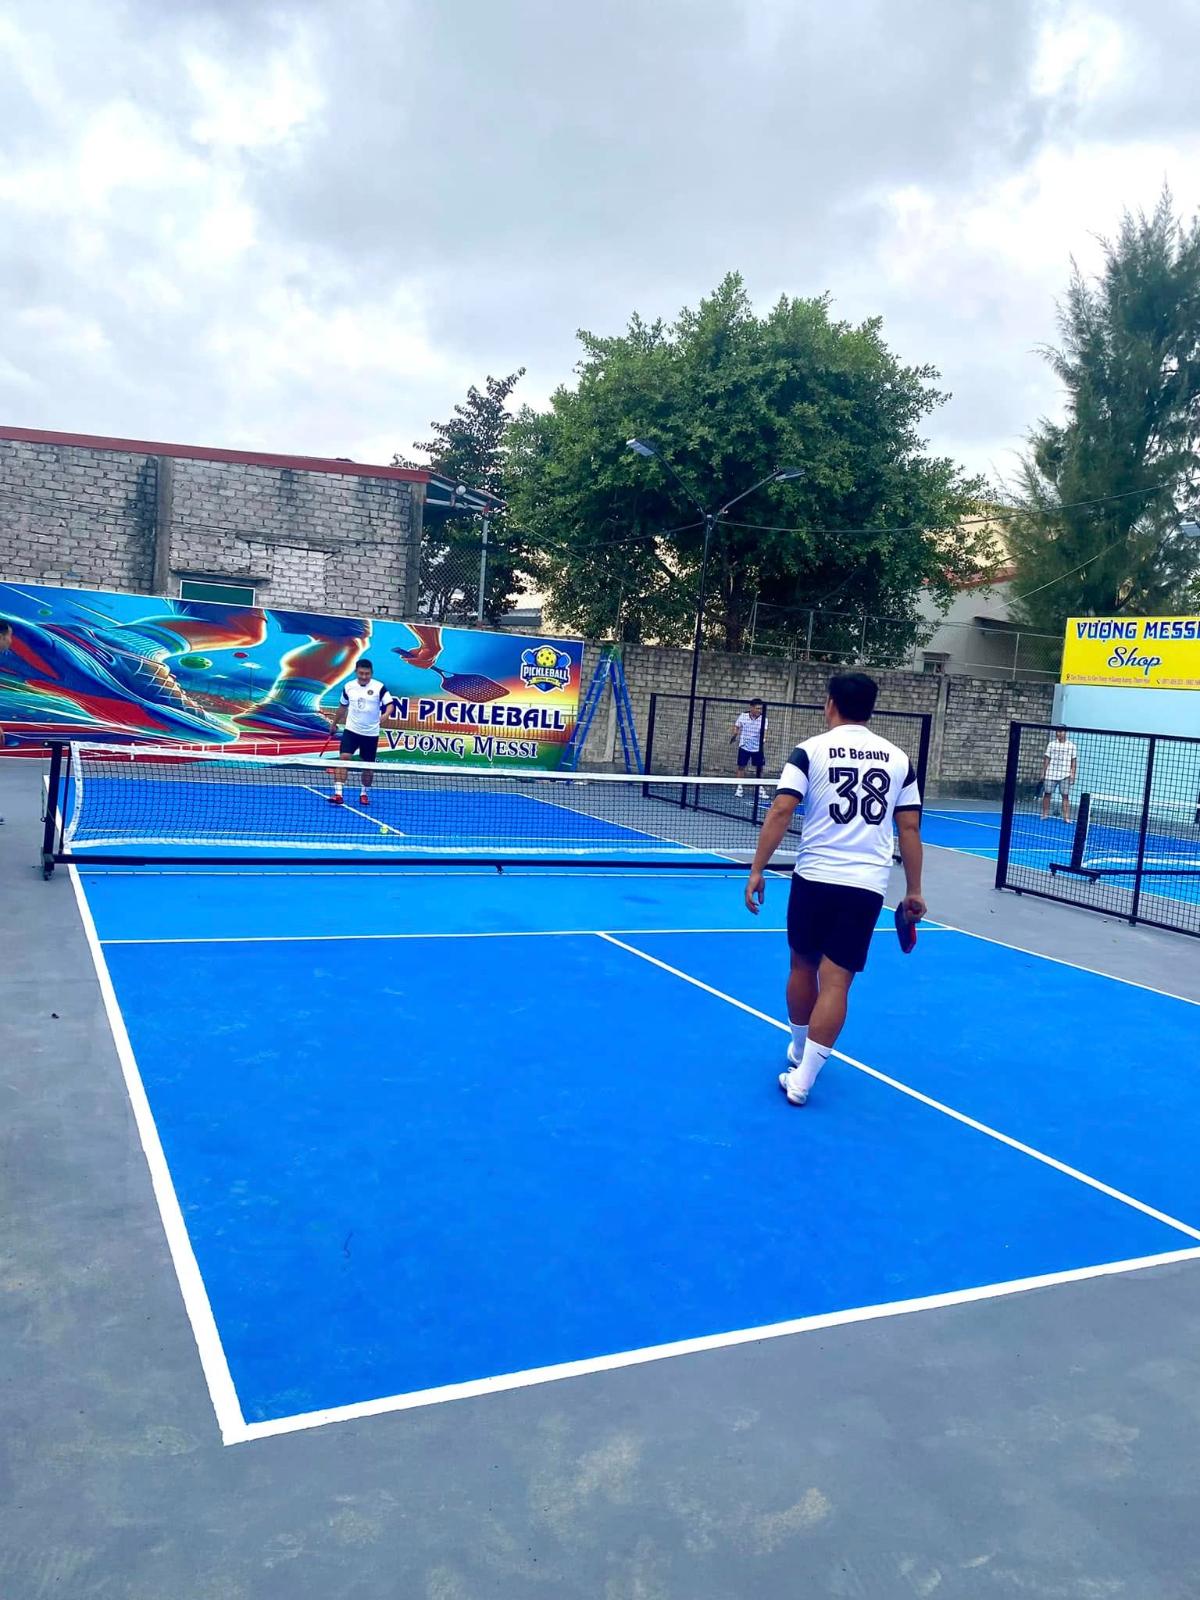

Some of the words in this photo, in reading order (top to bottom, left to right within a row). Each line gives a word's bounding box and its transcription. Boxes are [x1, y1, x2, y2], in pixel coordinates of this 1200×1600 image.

[1076, 620, 1138, 643] VƯỢNG
[523, 666, 568, 681] PICKLEBALL
[1107, 646, 1162, 676] Shop
[419, 699, 566, 731] PICKLEBALL
[384, 730, 465, 758] VƯỢNG
[472, 736, 538, 761] MESSI
[828, 748, 846, 759] DC
[849, 748, 890, 763] Beauty
[828, 767, 891, 826] 38
